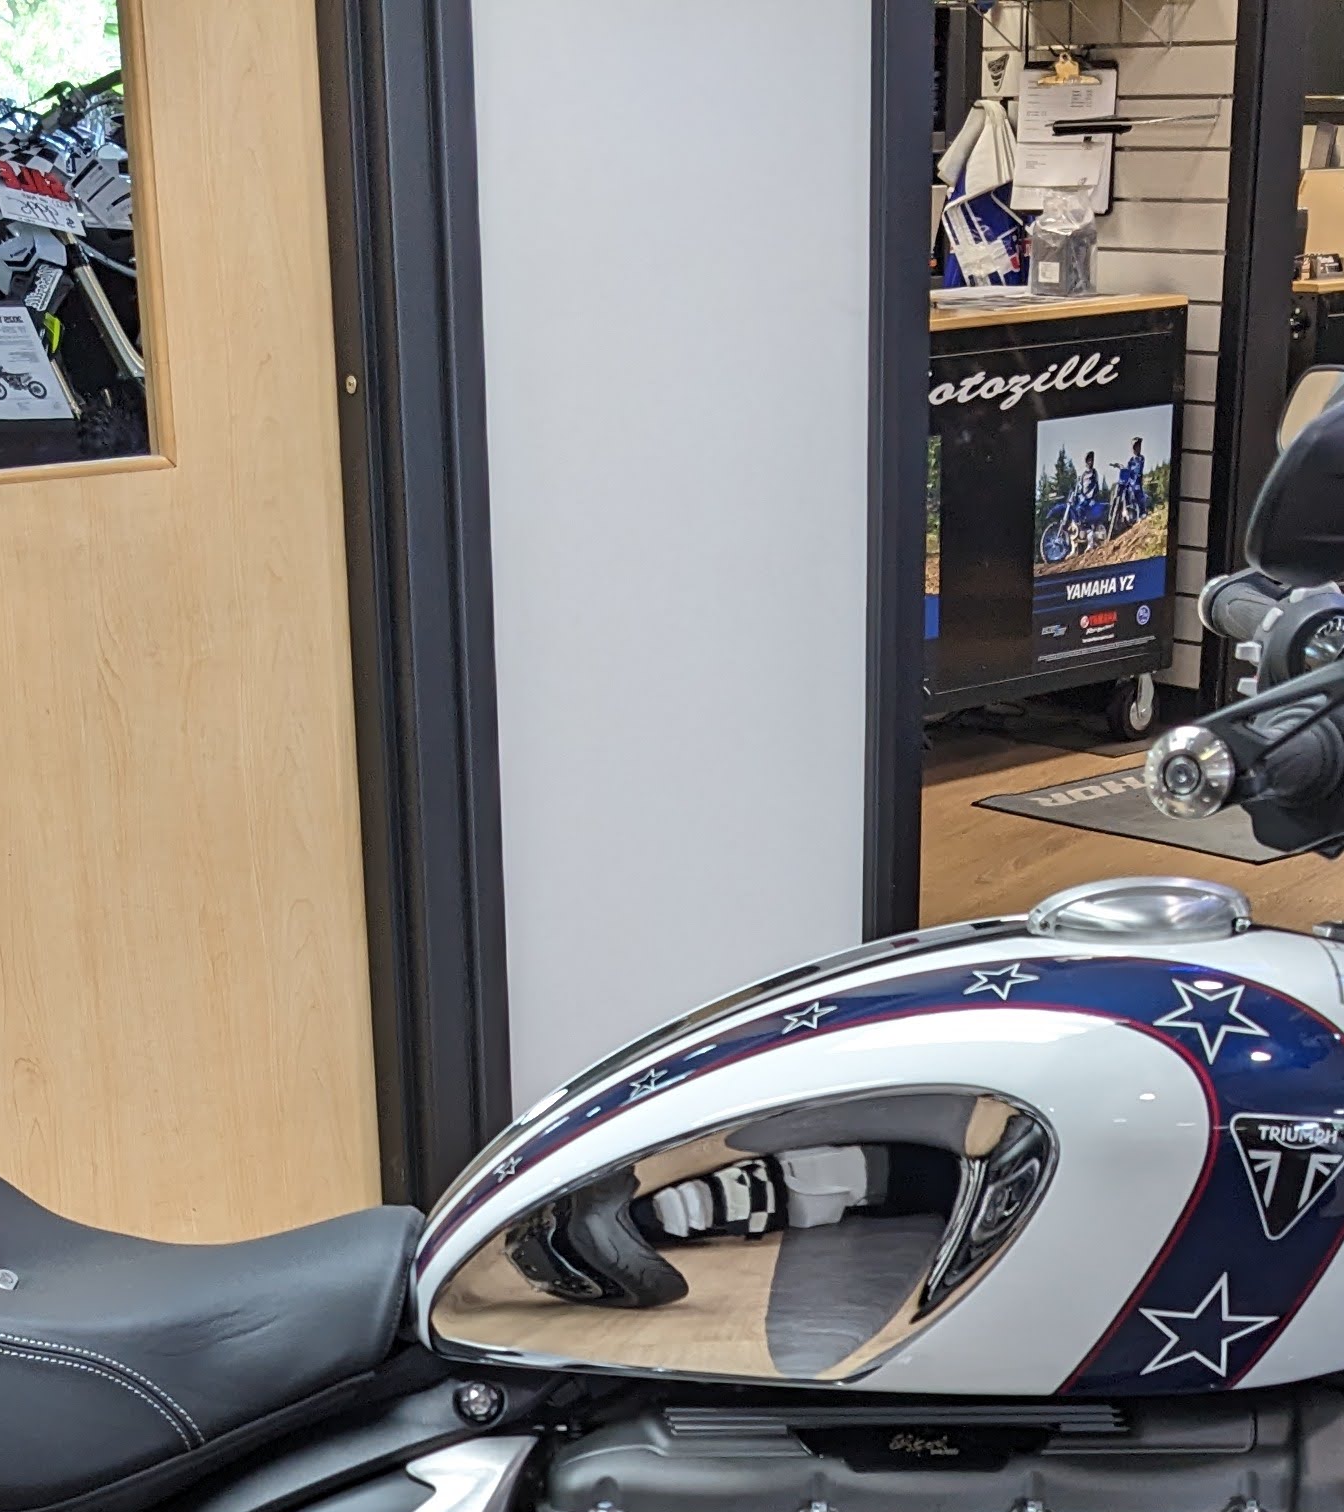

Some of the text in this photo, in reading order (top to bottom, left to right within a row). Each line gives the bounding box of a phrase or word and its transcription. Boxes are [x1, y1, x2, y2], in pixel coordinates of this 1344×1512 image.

[928, 352, 1121, 411] otozilli
[1066, 574, 1136, 601] YAMAHA YZ
[1031, 775, 1148, 808] HOR
[1257, 1122, 1339, 1147] TRIUMPH
